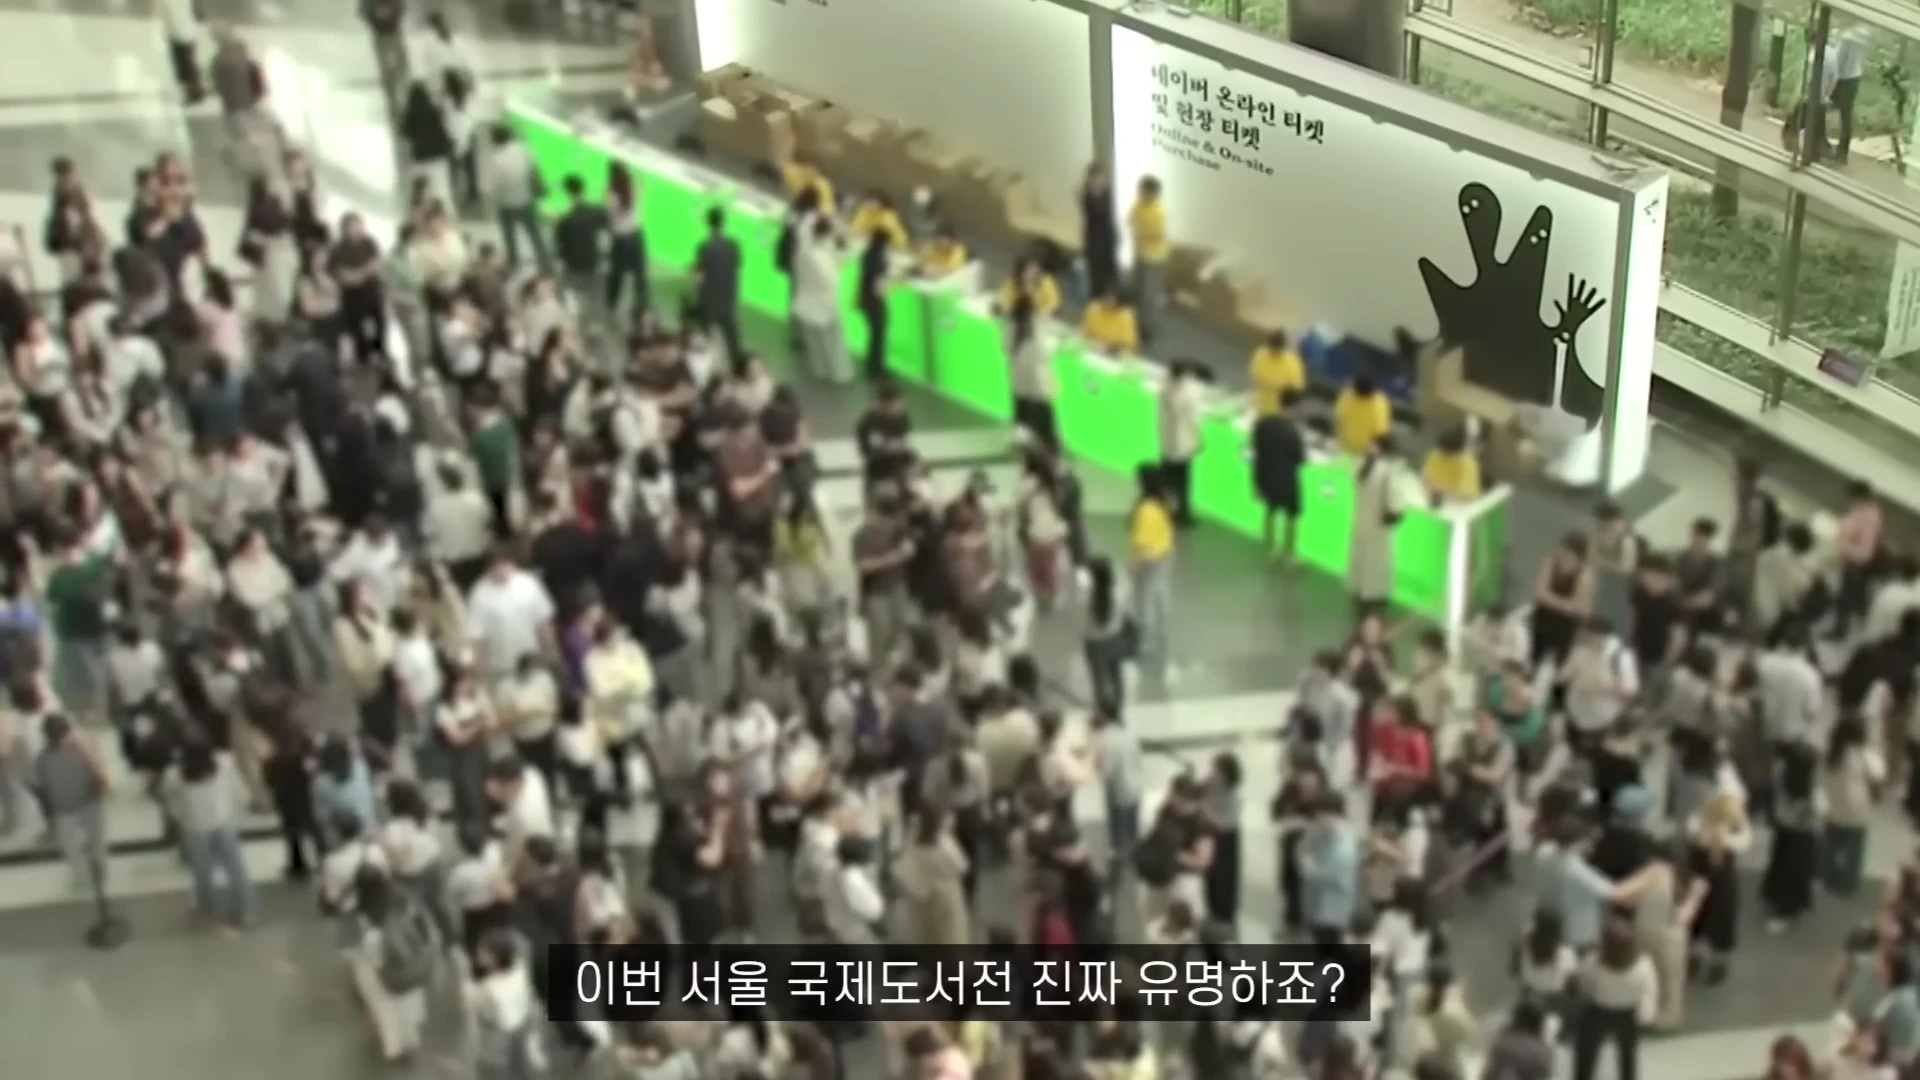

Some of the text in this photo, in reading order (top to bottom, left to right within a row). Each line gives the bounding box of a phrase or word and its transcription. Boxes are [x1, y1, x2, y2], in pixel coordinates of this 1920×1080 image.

[1151, 63, 1324, 145] 네이버 온라인 티켓
[1176, 101, 1214, 133] 현장
[1221, 118, 1260, 151] 티켓
[1219, 146, 1274, 177] On-site
